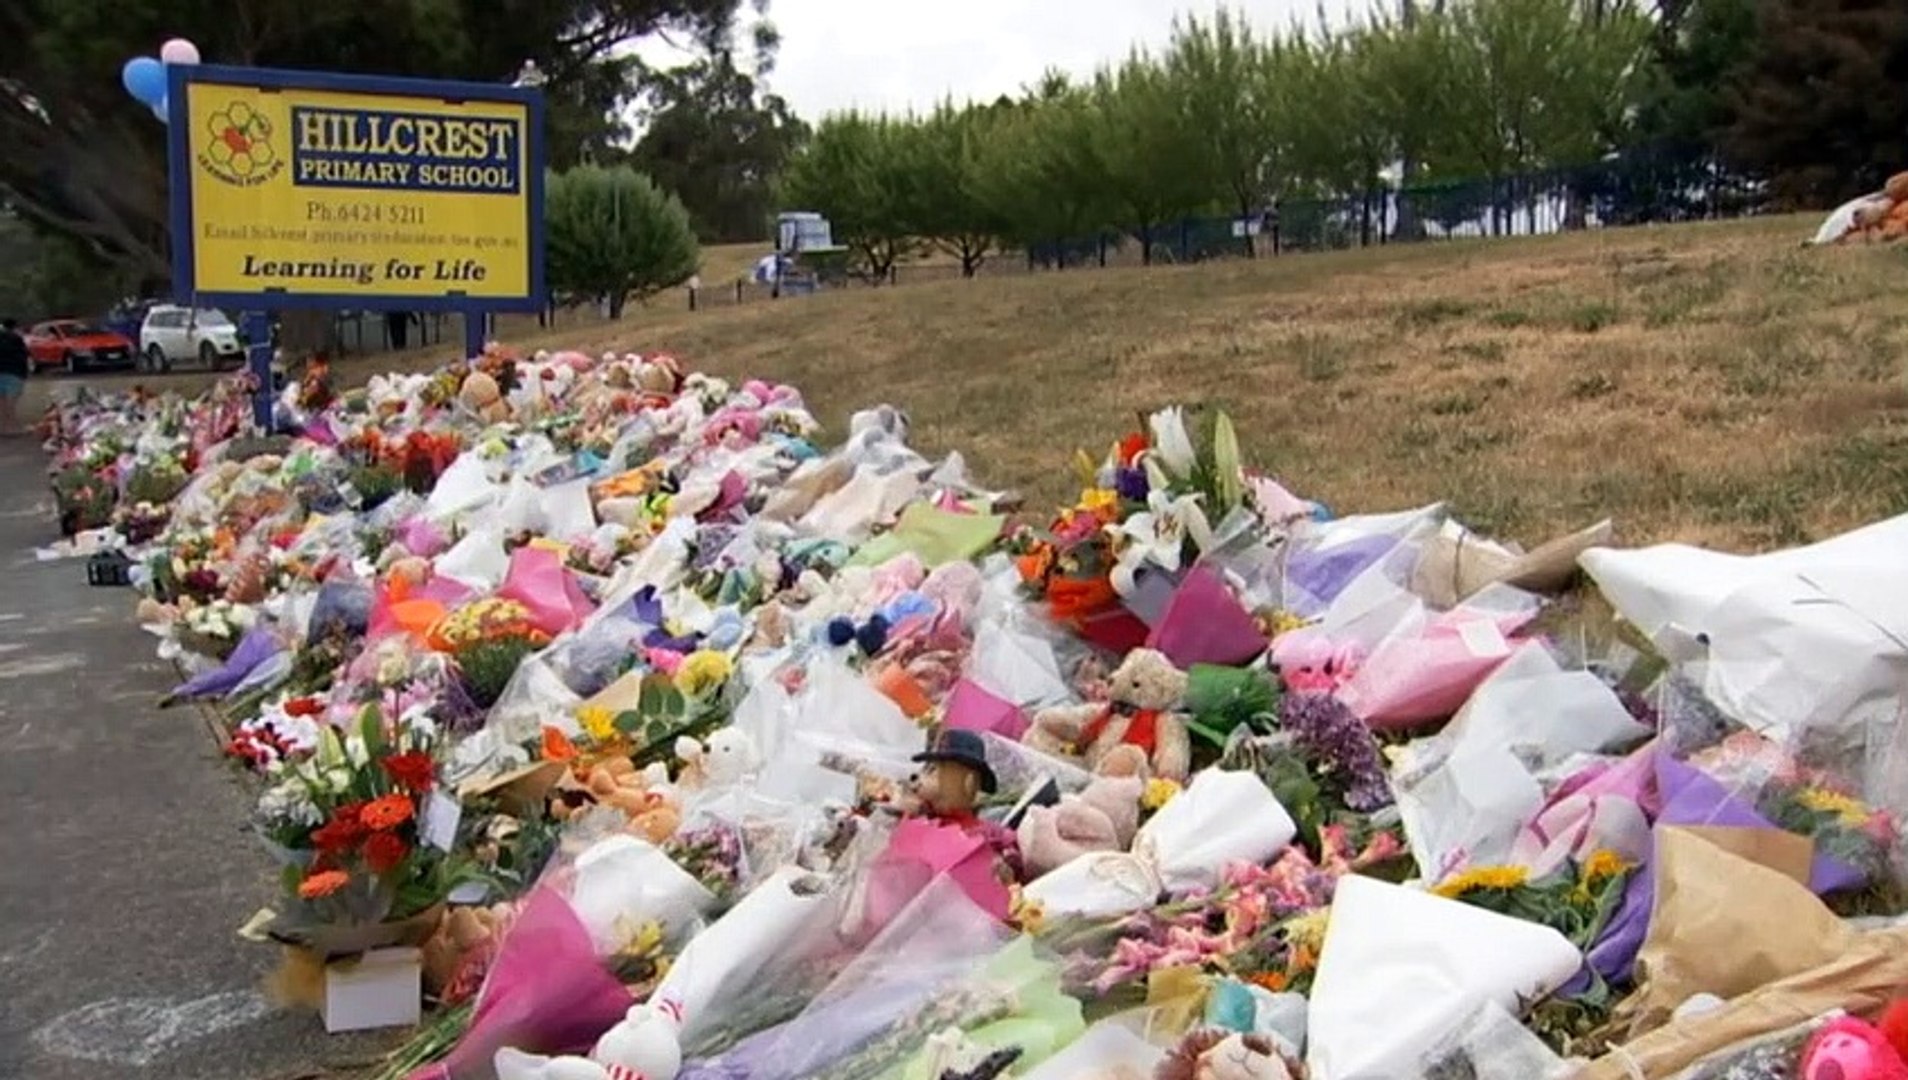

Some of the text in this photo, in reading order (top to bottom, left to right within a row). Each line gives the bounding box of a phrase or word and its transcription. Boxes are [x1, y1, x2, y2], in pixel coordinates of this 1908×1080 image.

[299, 112, 513, 160] HILLCREST
[301, 160, 514, 188] PRIMARY SCHOOL
[388, 204, 424, 224] 5211
[242, 255, 486, 284] Learning for Life
